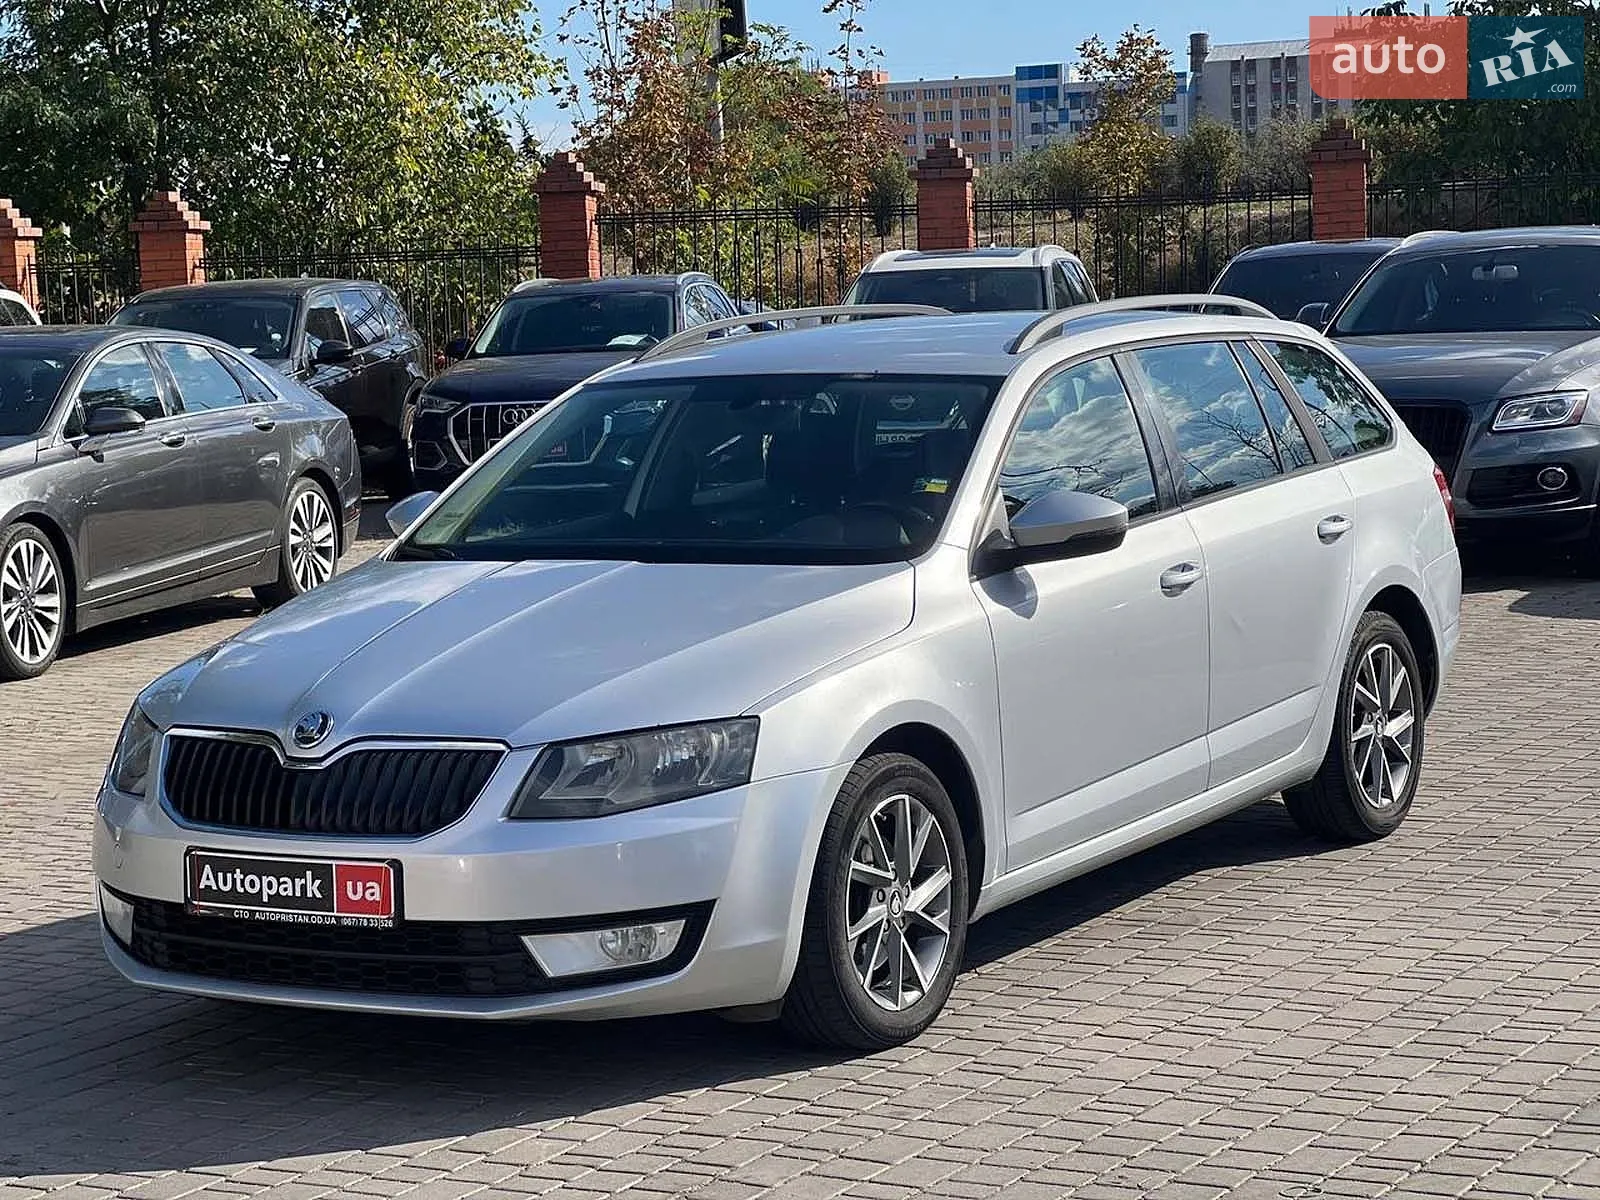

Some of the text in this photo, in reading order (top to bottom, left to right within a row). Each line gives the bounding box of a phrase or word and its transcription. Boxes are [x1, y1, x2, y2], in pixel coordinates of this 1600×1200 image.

[199, 864, 382, 902] Autopark ua
[254, 911, 337, 925] AUTOPRISTAN.OD.UA
